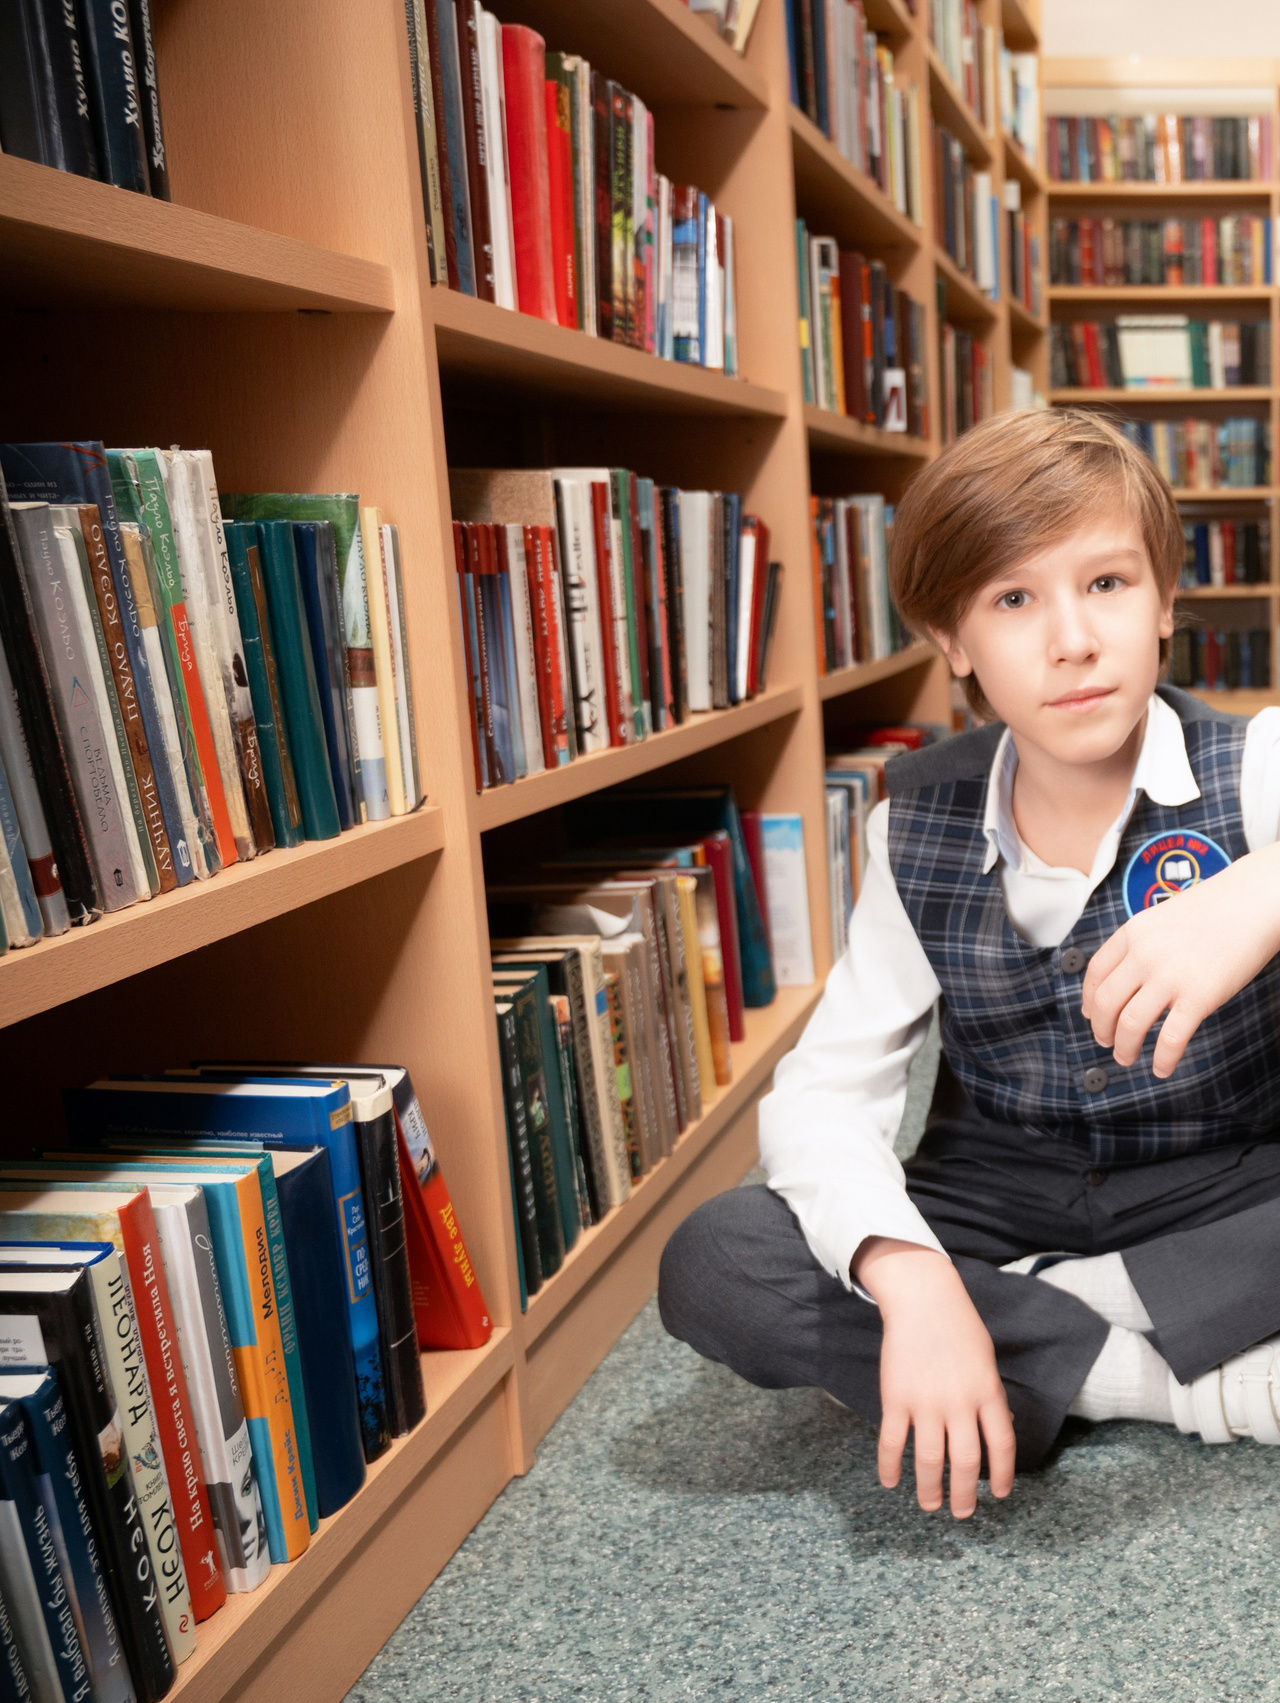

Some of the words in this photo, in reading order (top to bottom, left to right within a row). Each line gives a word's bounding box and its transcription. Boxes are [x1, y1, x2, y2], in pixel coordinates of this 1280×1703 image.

[70, 38, 90, 121] Хулио
[121, 49, 141, 129] Хулио
[144, 476, 164, 529] Пауло
[90, 523, 118, 625] КОЭЛЬО
[177, 614, 194, 672] Брида
[114, 641, 139, 721] ПАУЛО
[246, 731, 262, 789] Брида
[141, 772, 172, 871] ЛУЧНИК
[140, 1242, 156, 1286] Ноя
[253, 1226, 275, 1321] Мелодия
[439, 1202, 459, 1241] Две
[453, 1241, 476, 1290] луны
[149, 1284, 175, 1382] встретила
[169, 1383, 179, 1396] я
[170, 1398, 190, 1449] света
[64, 1449, 83, 1499] тебя
[107, 1272, 148, 1427] ЛЕОНАРД
[150, 1498, 186, 1605] КОЭН
[179, 1451, 200, 1500] краю
[288, 1472, 304, 1521] Джим
[33, 1504, 60, 1576] жизнь
[186, 1498, 205, 1532] На
[123, 1494, 156, 1613] КОЭН
[47, 1573, 68, 1609] бы
[60, 1604, 87, 1682] выбрал
